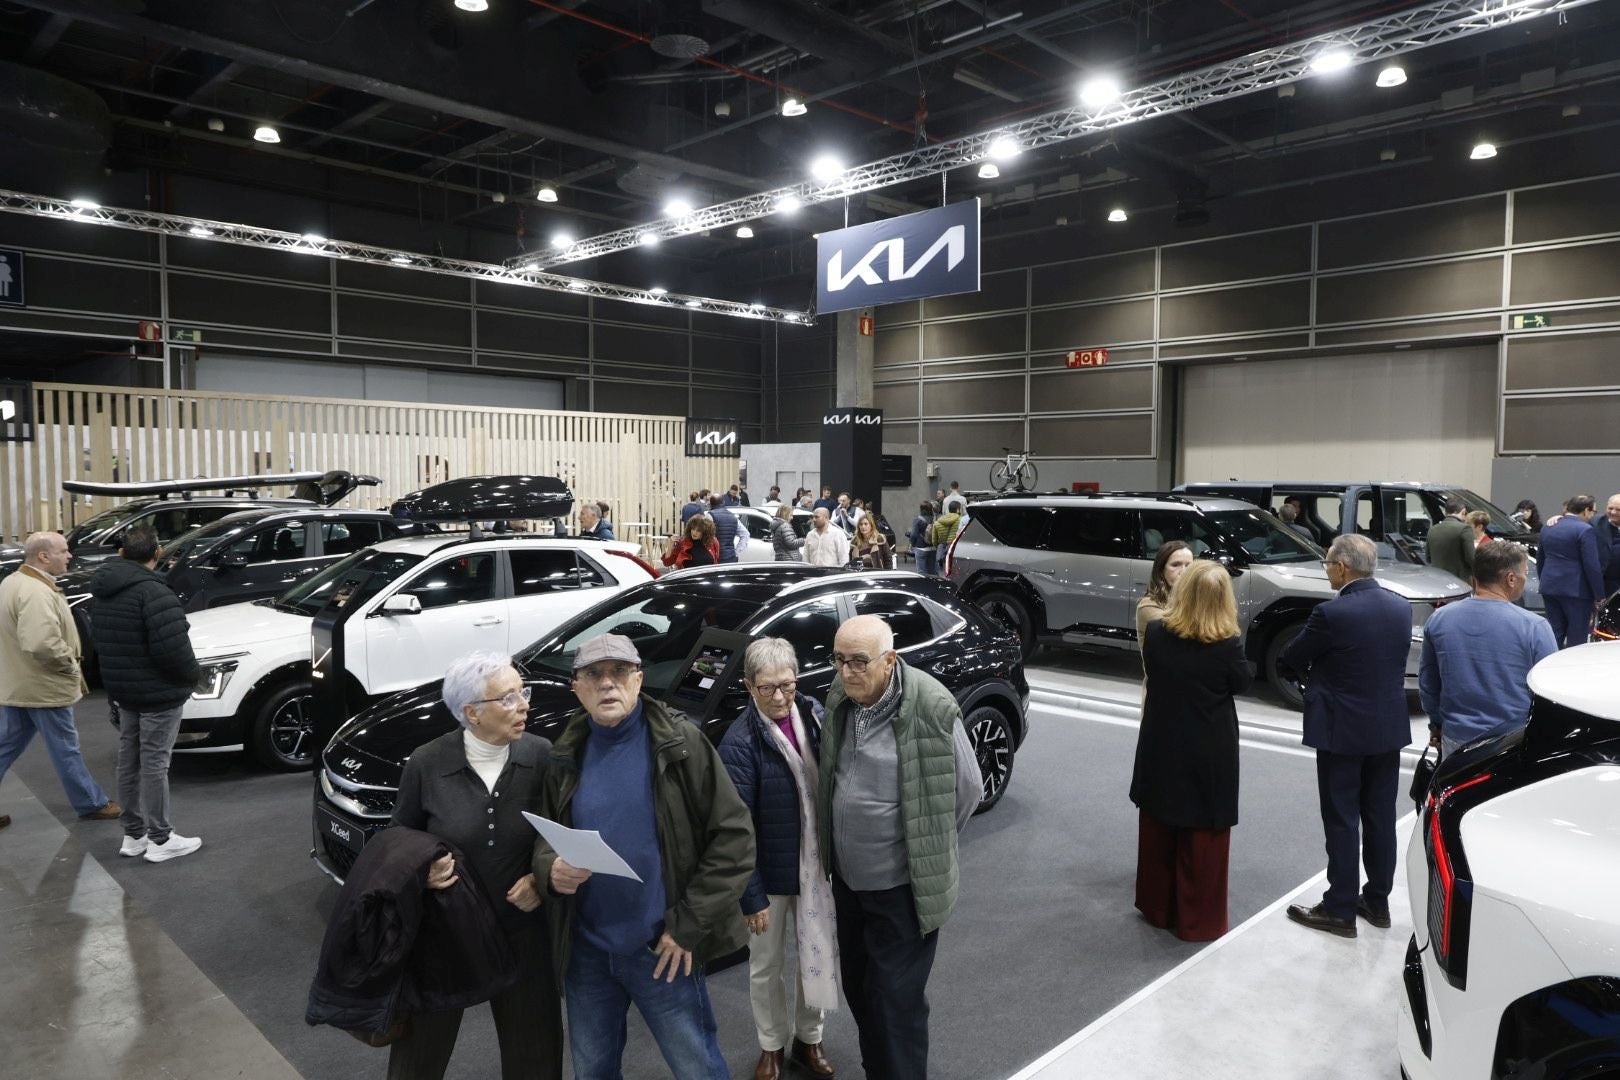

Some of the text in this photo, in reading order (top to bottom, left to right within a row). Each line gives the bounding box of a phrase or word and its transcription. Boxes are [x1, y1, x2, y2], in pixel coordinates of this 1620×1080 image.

[827, 224, 965, 292] KIA
[823, 414, 851, 425] KIA
[855, 415, 881, 425] KIA
[696, 430, 736, 445] KIA
[341, 757, 363, 770] KIA
[330, 820, 350, 841] XCeed
